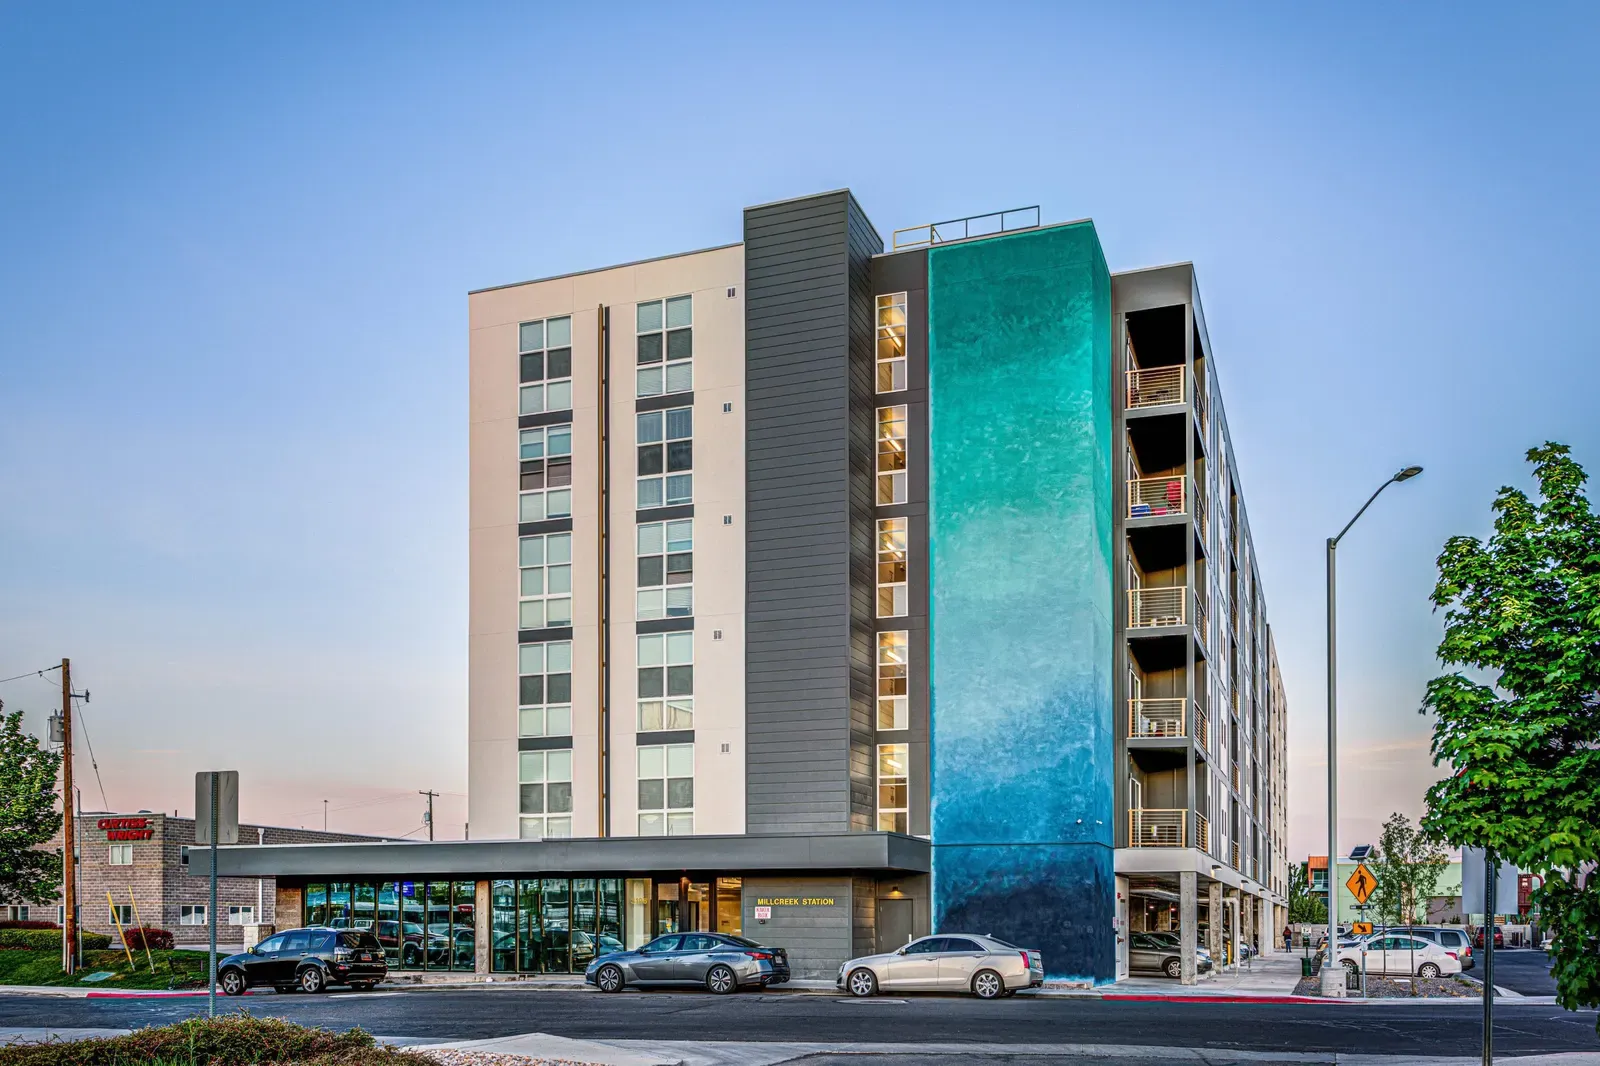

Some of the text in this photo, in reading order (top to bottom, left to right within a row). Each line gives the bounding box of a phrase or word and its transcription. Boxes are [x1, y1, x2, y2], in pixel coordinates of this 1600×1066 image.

[107, 829, 154, 841] WRIGHT
[757, 898, 834, 906] MILLCREEK STATION
